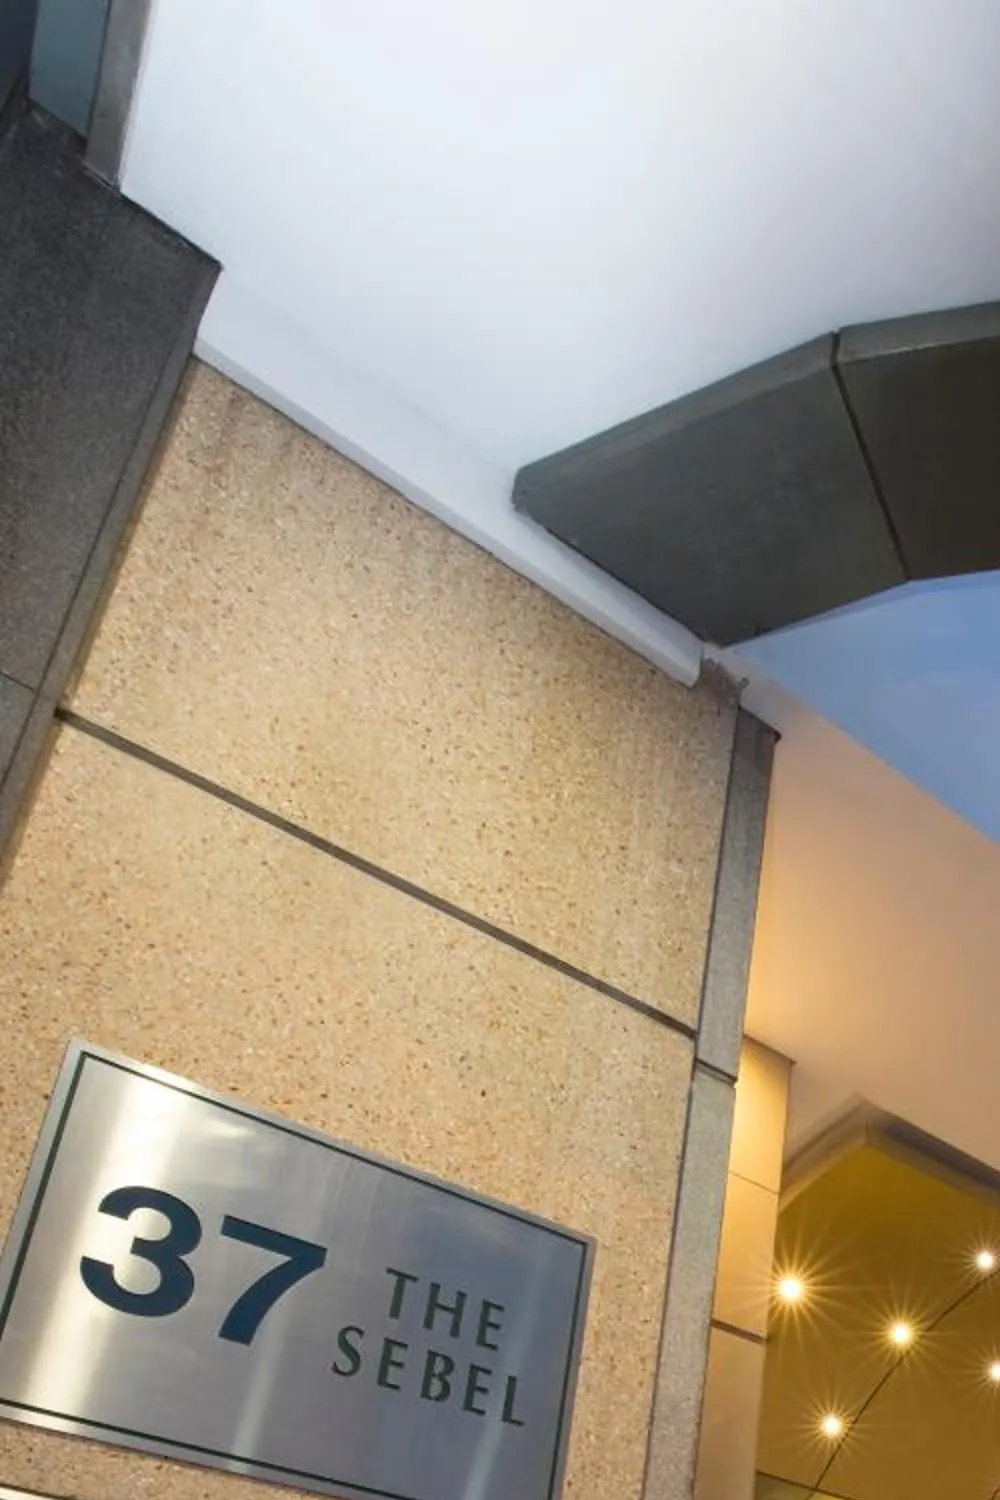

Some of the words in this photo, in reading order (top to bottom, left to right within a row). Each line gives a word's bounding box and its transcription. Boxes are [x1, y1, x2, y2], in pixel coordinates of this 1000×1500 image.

[80, 1186, 327, 1345] 37
[386, 1268, 505, 1351] THE
[331, 1326, 525, 1426] SEBEL
